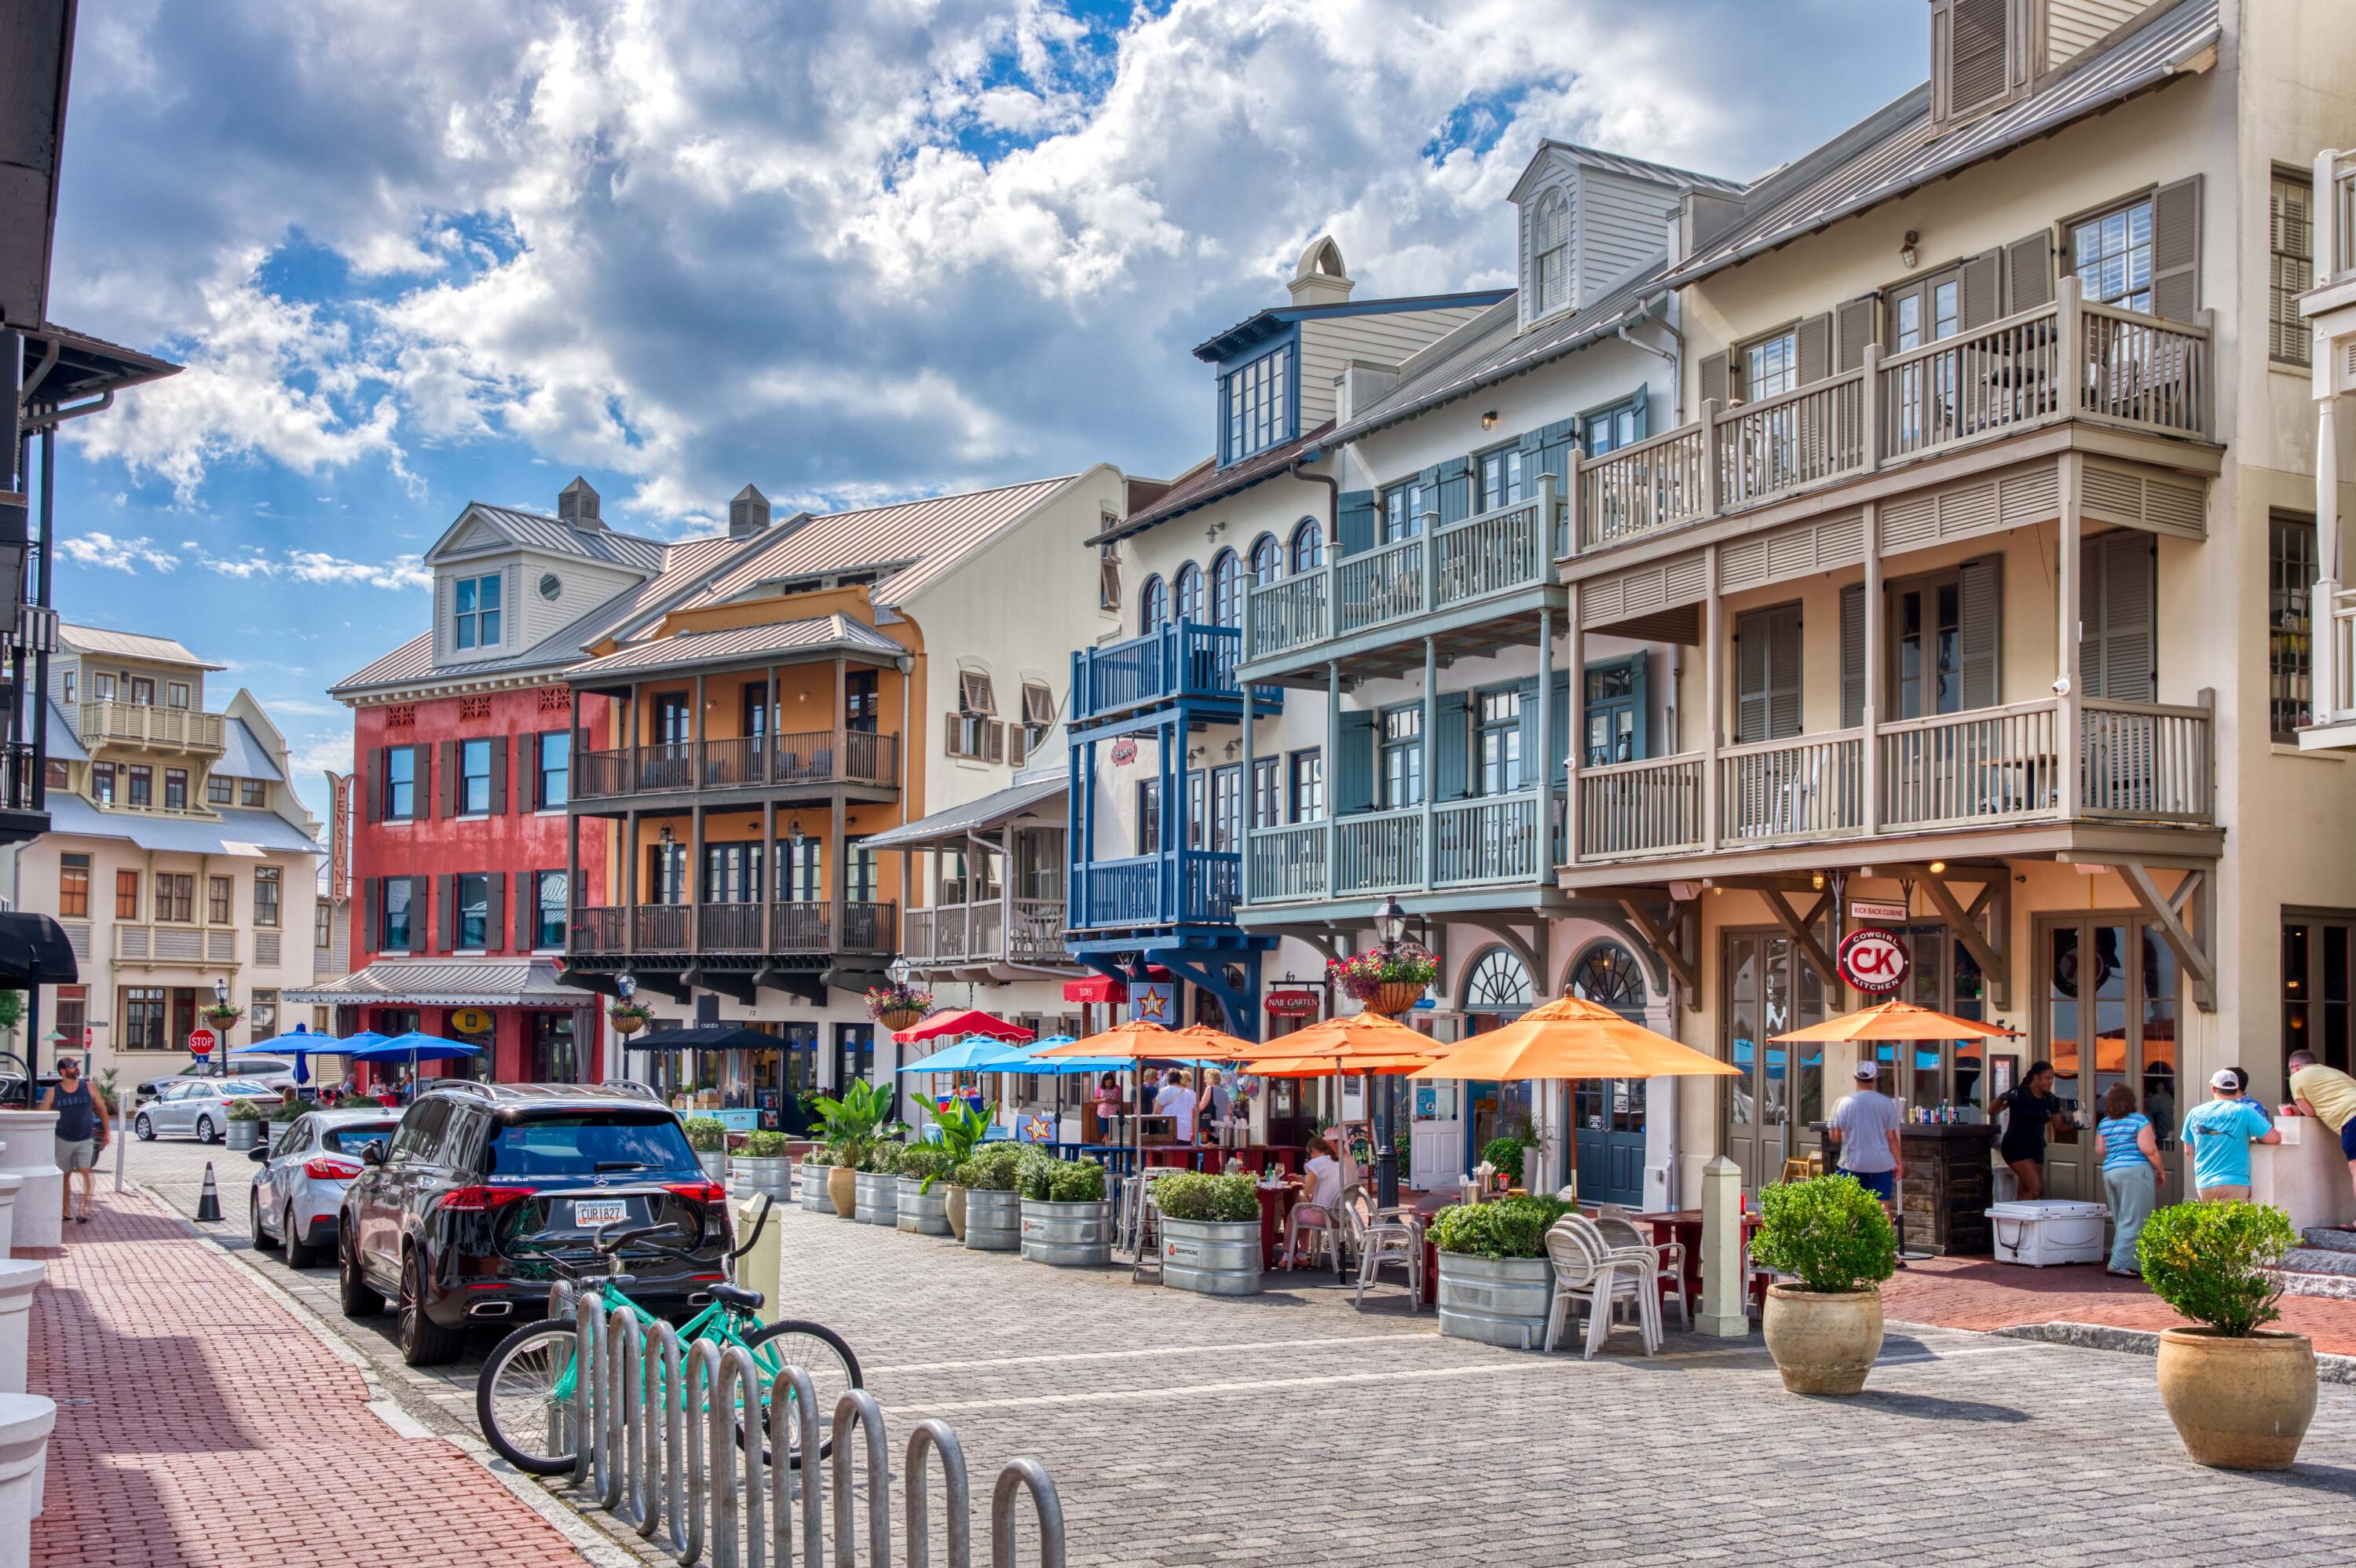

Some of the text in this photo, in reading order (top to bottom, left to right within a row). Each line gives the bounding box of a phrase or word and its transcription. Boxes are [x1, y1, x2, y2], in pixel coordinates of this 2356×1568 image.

[335, 786, 346, 896] PENSIONE
[1882, 908, 1904, 917] CUISINE
[1853, 931, 1898, 947] COWGIRL
[1852, 947, 1896, 975] CK
[1853, 977, 1899, 991] KITCHEN
[1079, 988, 1093, 996] TOYS
[191, 1037, 214, 1047] STOP
[581, 1207, 620, 1221] CUR1827
